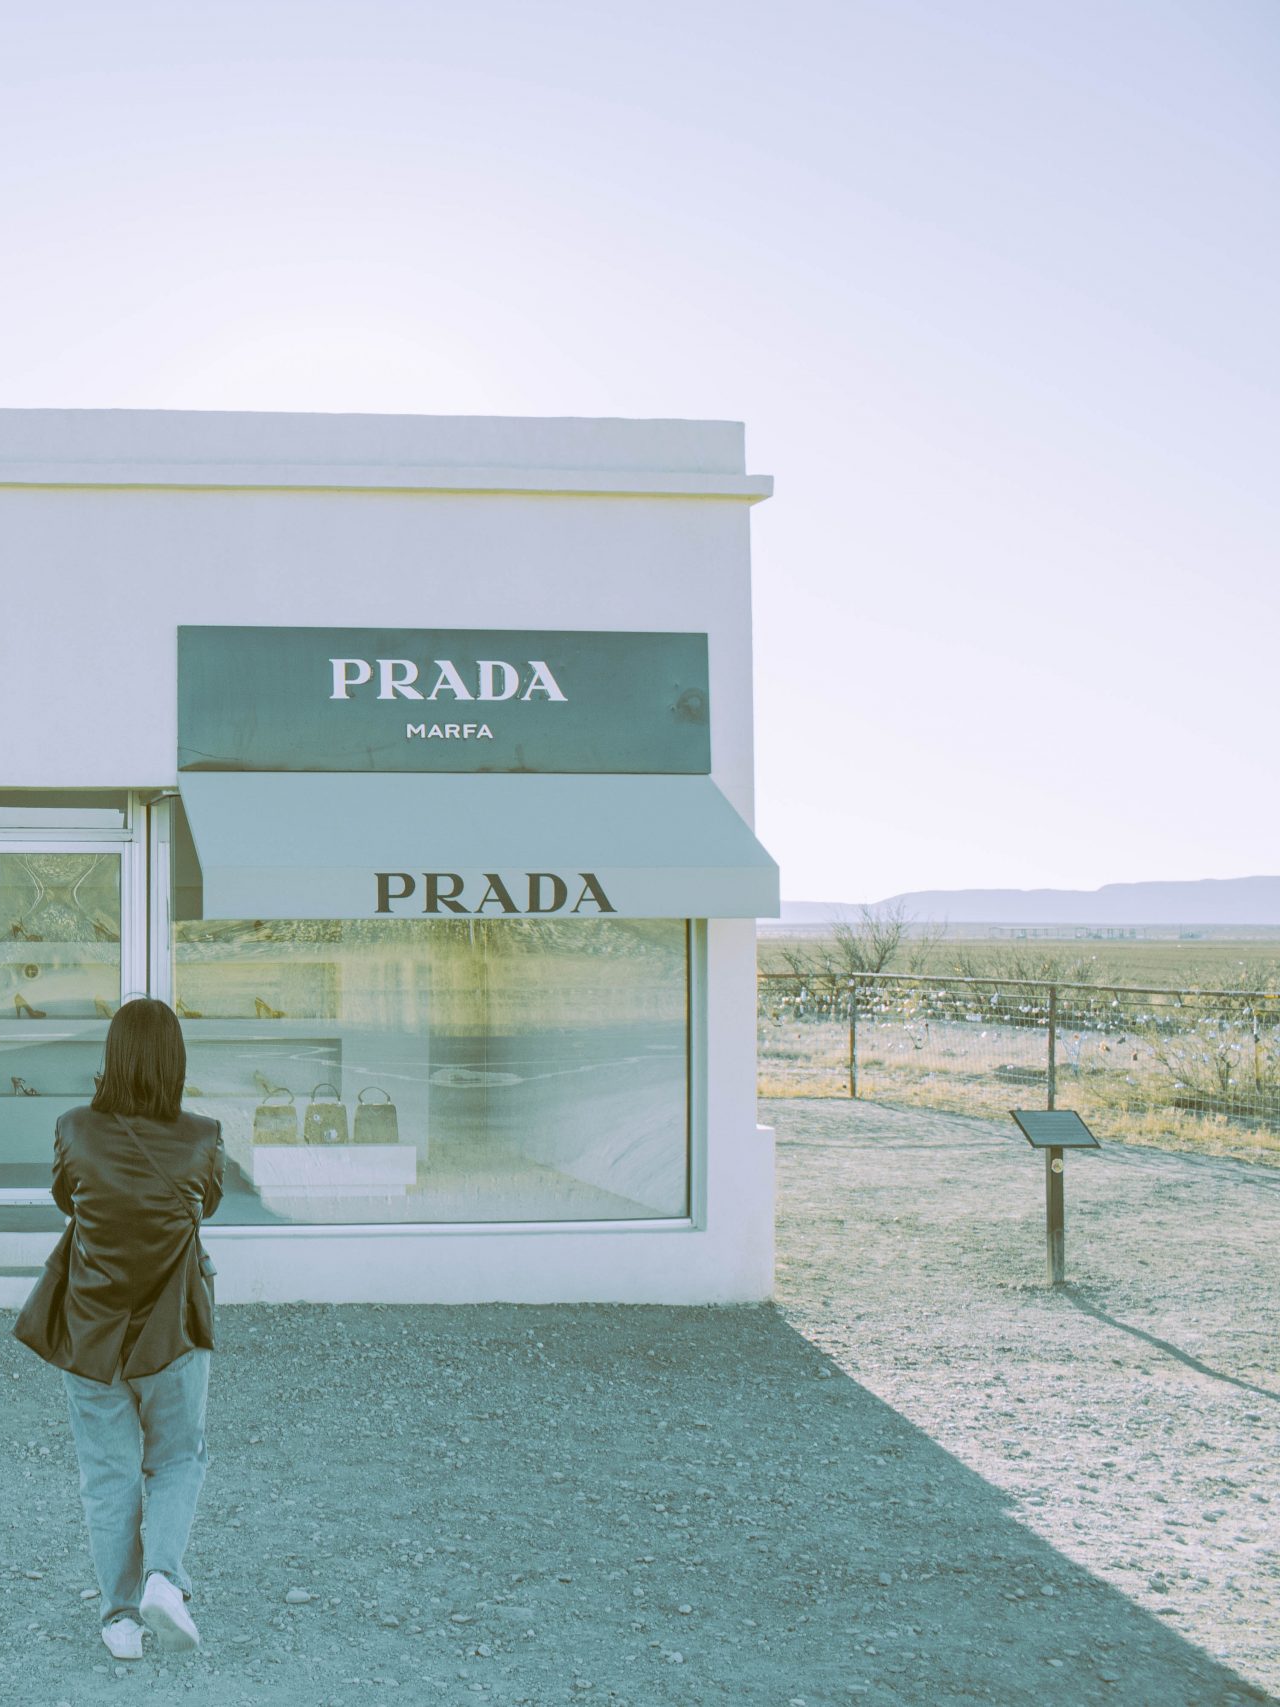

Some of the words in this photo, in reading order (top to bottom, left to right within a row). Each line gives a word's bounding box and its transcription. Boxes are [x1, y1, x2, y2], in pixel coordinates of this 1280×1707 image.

[328, 658, 569, 702] PRADA
[405, 722, 495, 740] MARFA
[374, 872, 618, 914] PRADA
